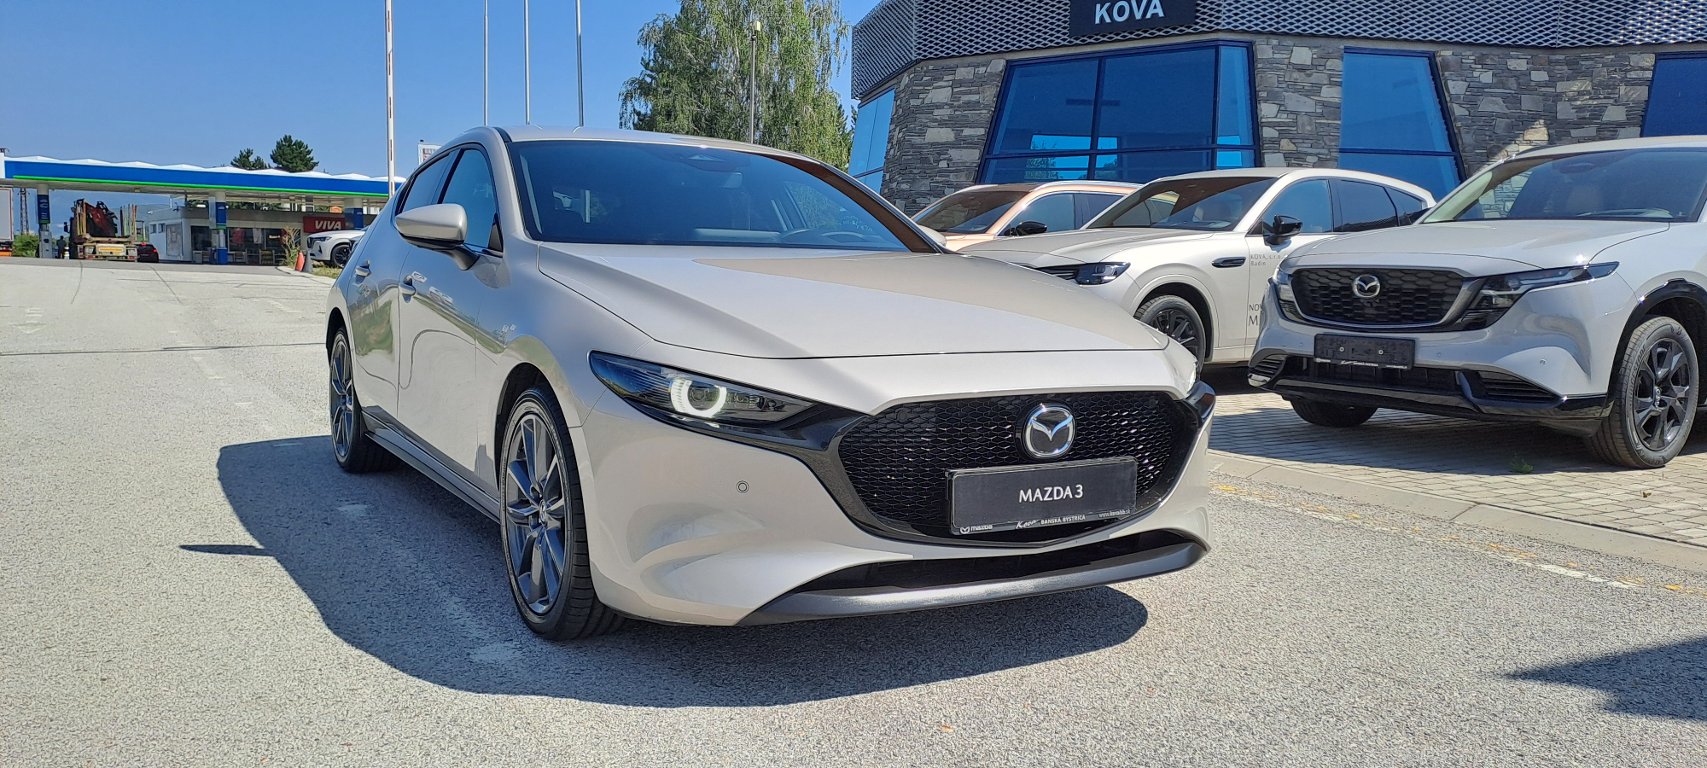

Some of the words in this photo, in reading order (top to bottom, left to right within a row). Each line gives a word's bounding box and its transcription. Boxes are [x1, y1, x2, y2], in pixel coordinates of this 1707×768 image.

[1095, 0, 1165, 25] KOVA
[315, 220, 341, 230] VIVA
[1019, 485, 1073, 503] MAZDA
[1074, 484, 1084, 499] 3
